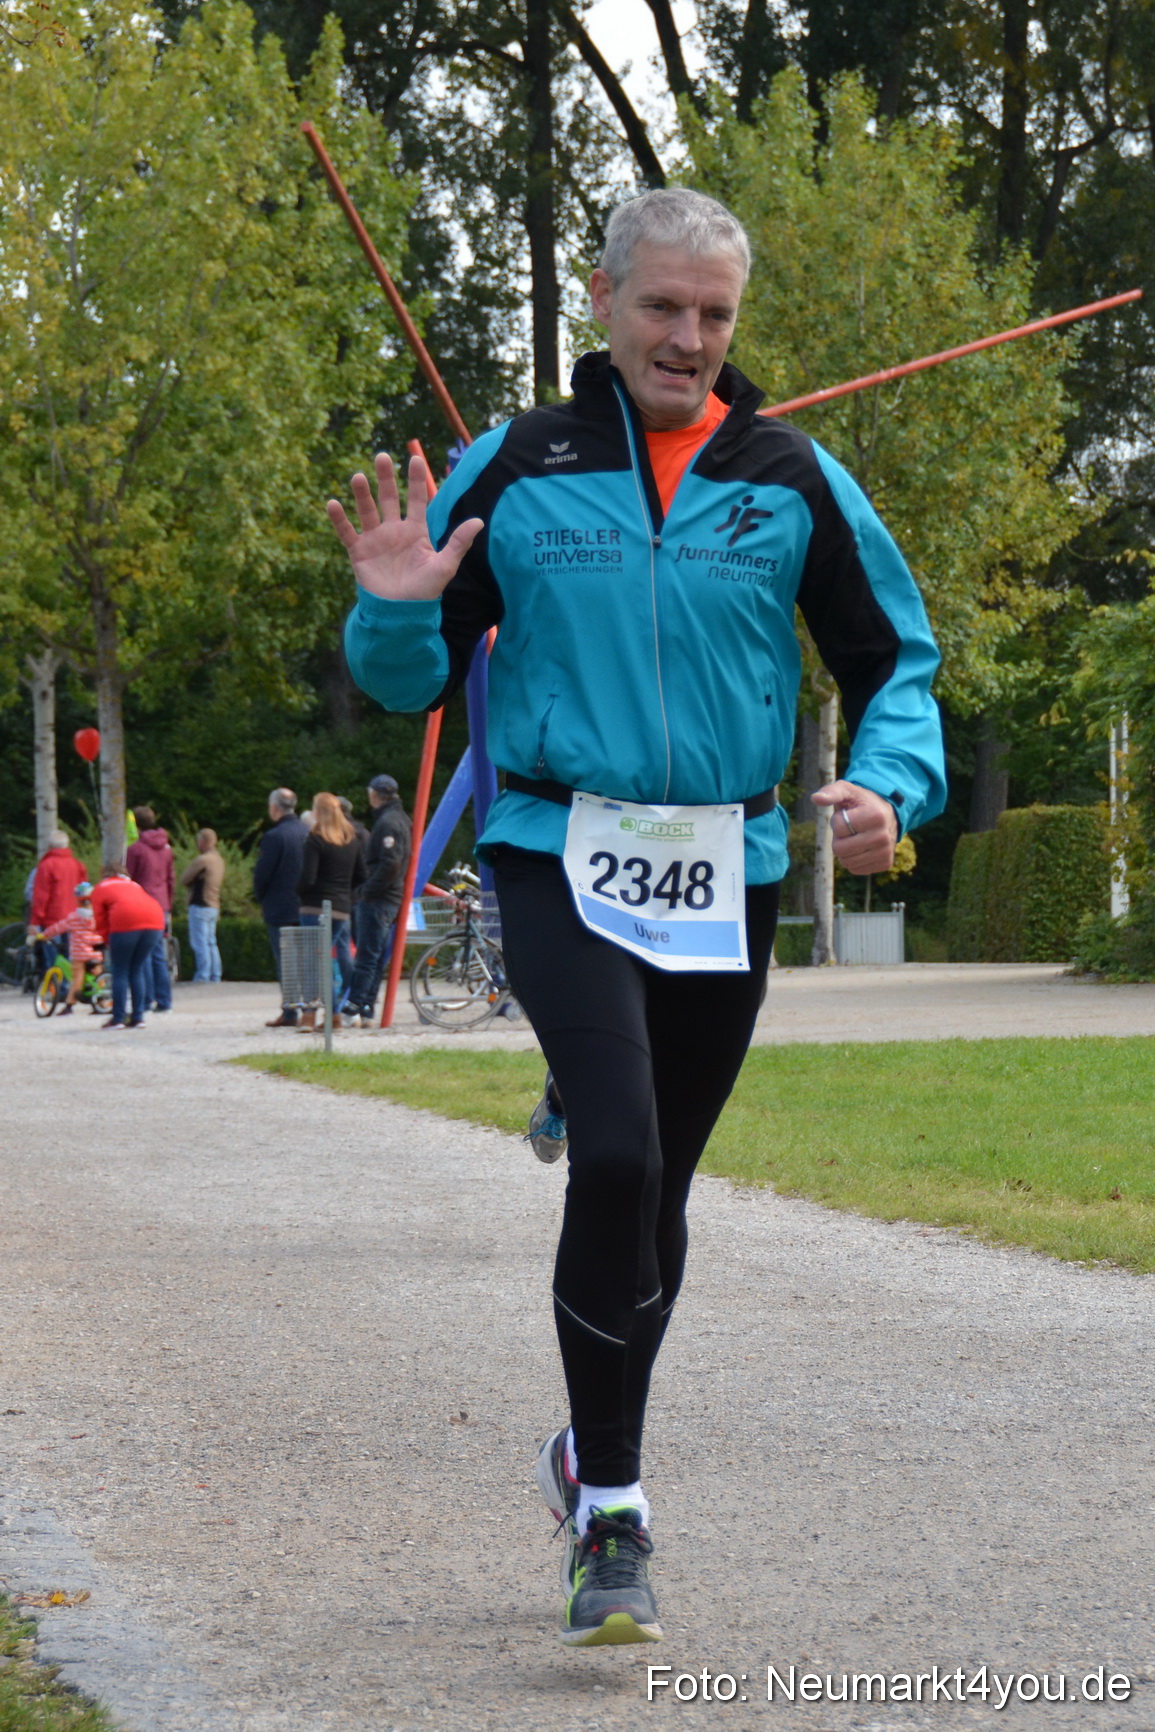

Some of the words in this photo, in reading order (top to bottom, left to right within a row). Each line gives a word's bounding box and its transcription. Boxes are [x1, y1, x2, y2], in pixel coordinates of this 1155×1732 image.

[544, 452, 578, 465] erima
[533, 529, 621, 546] STIEGLER
[675, 544, 778, 571] funrunners
[536, 565, 623, 575] VERSICHERUNGEN
[637, 820, 694, 837] BOCK
[589, 851, 715, 910] 2348
[634, 922, 670, 943] Uwe
